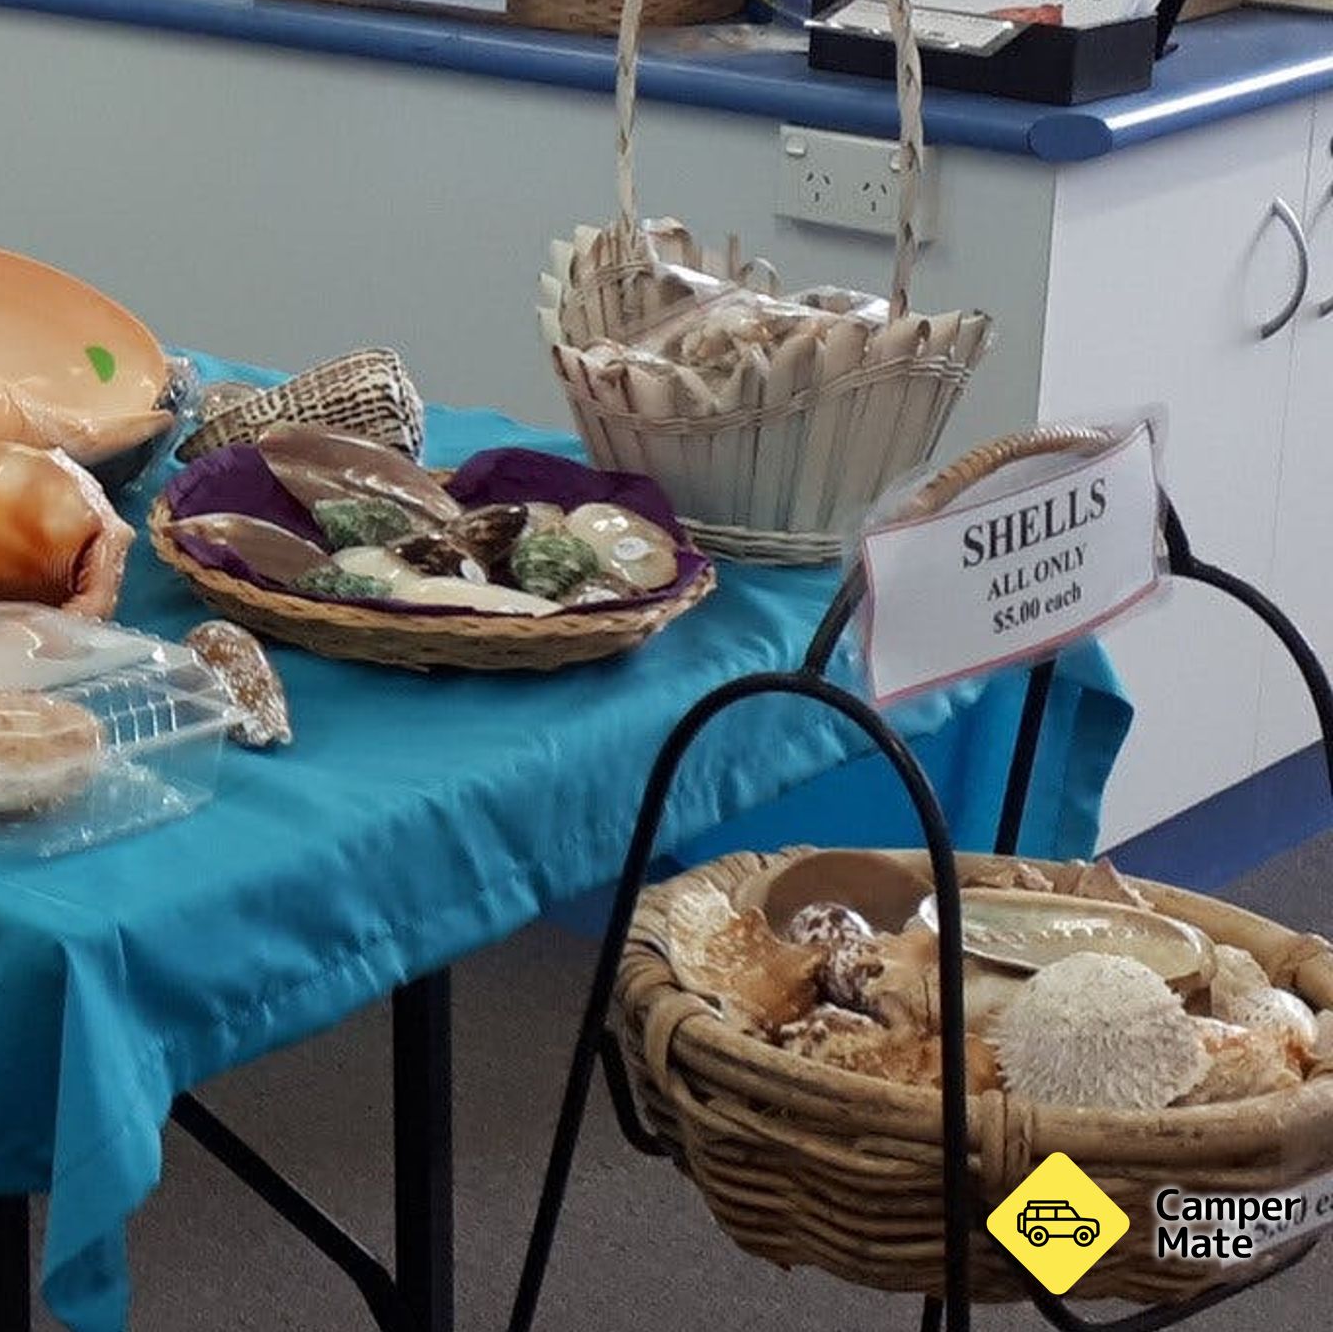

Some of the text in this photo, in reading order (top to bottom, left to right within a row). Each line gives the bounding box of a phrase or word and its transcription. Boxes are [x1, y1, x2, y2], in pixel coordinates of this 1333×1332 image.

[963, 477, 1107, 569] SHELLS
[987, 542, 1090, 602] ALL ONLY
[992, 581, 1082, 634] $5.00 each
